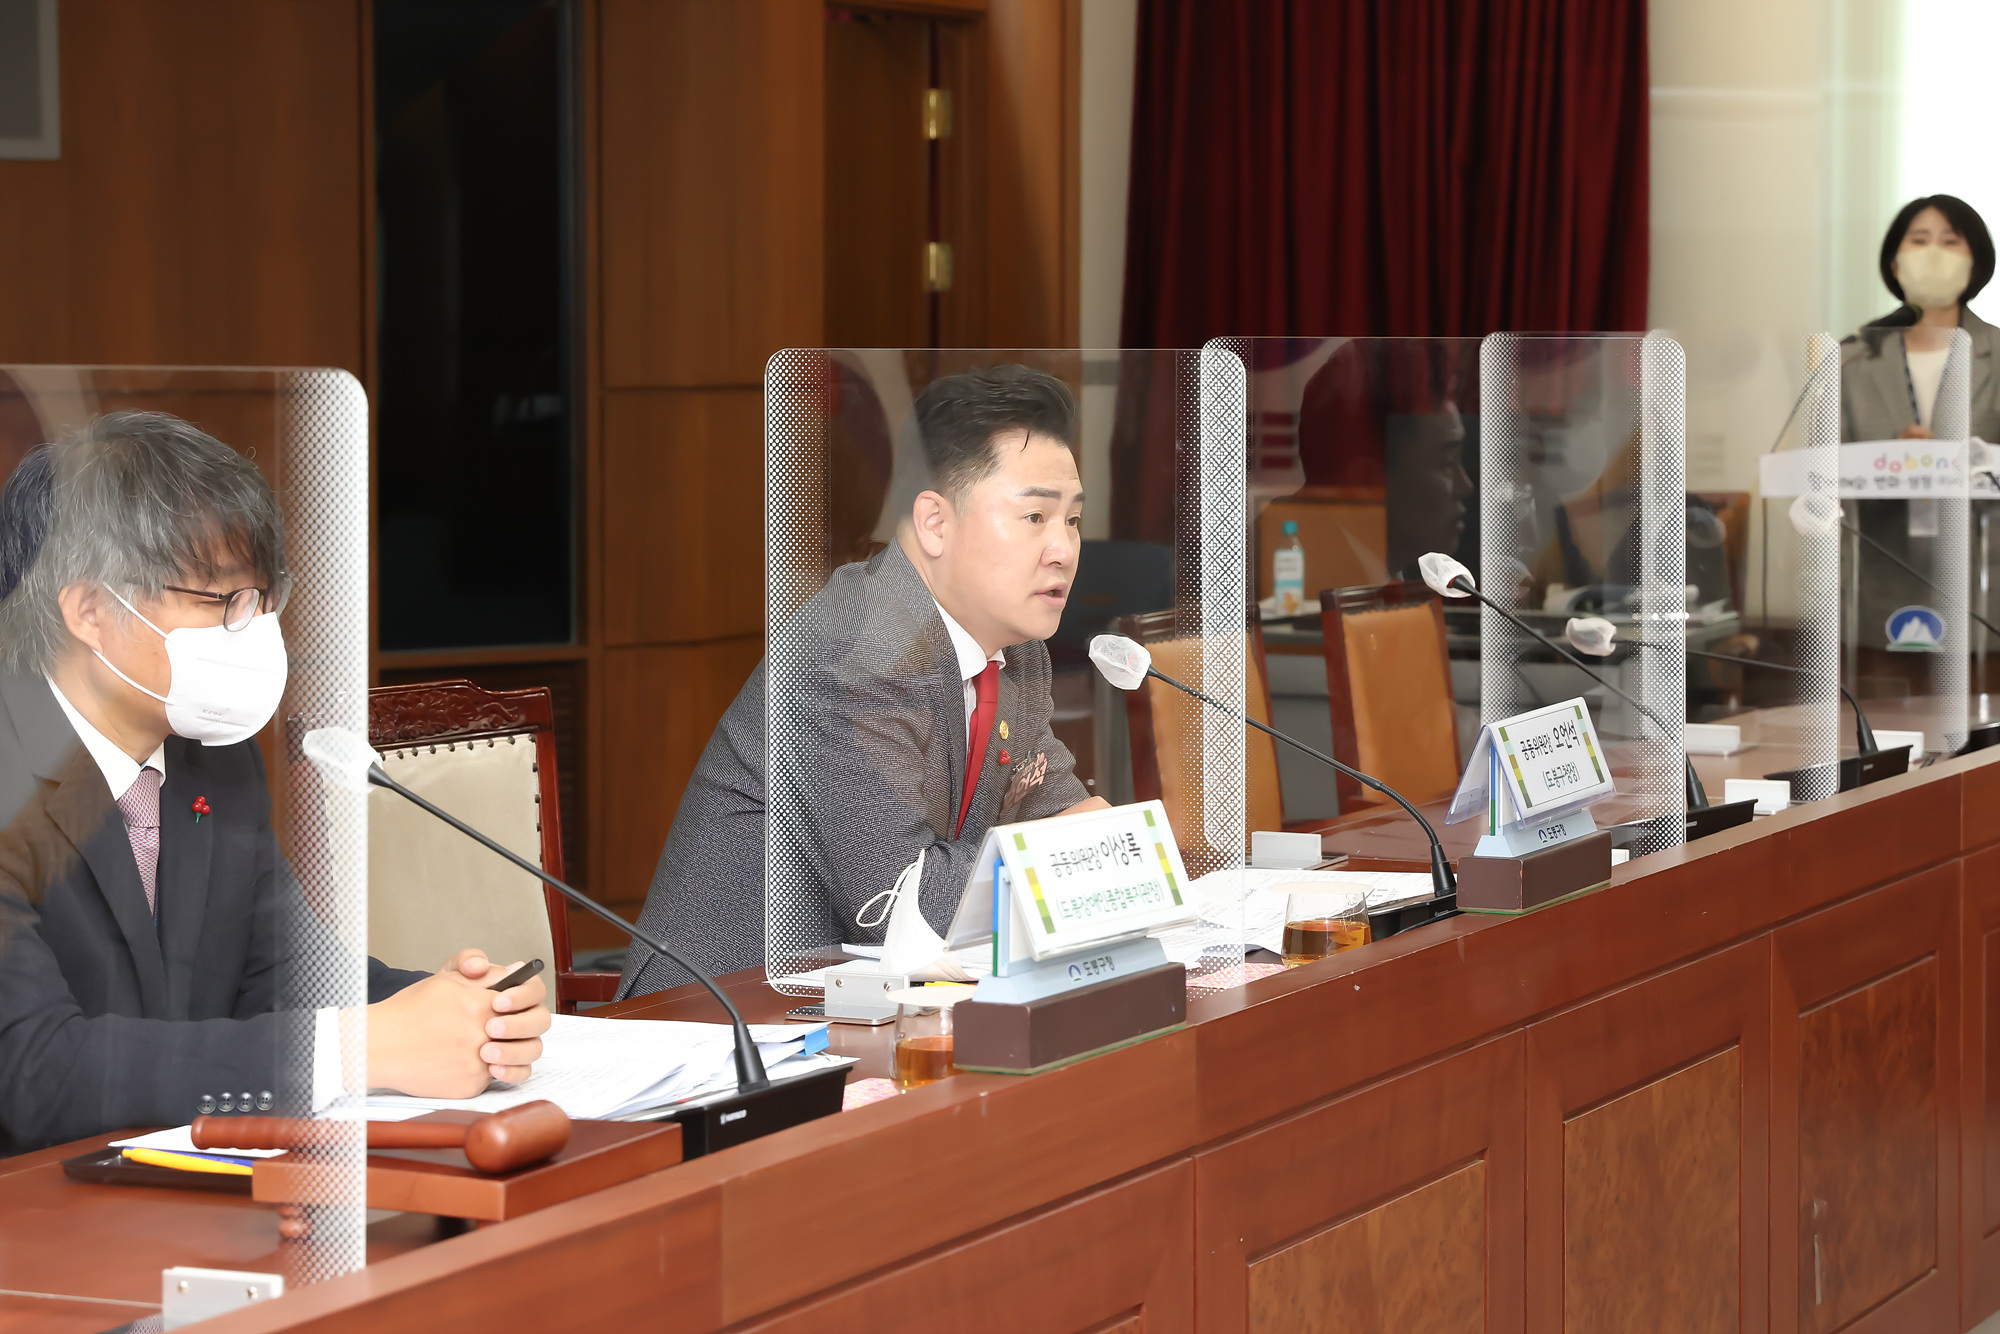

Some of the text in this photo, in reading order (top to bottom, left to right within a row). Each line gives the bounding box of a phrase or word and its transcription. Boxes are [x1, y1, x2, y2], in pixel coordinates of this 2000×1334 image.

[1520, 719, 1581, 761] 공동위원장 오언석
[1542, 761, 1581, 790] (도봉구청장)
[1546, 823, 1567, 839] 도봉구청
[1050, 832, 1143, 878] 공동위원장 이상록
[1056, 879, 1164, 921] (도봉장애인종합복지관장)
[1083, 957, 1115, 976] 도봉구청
